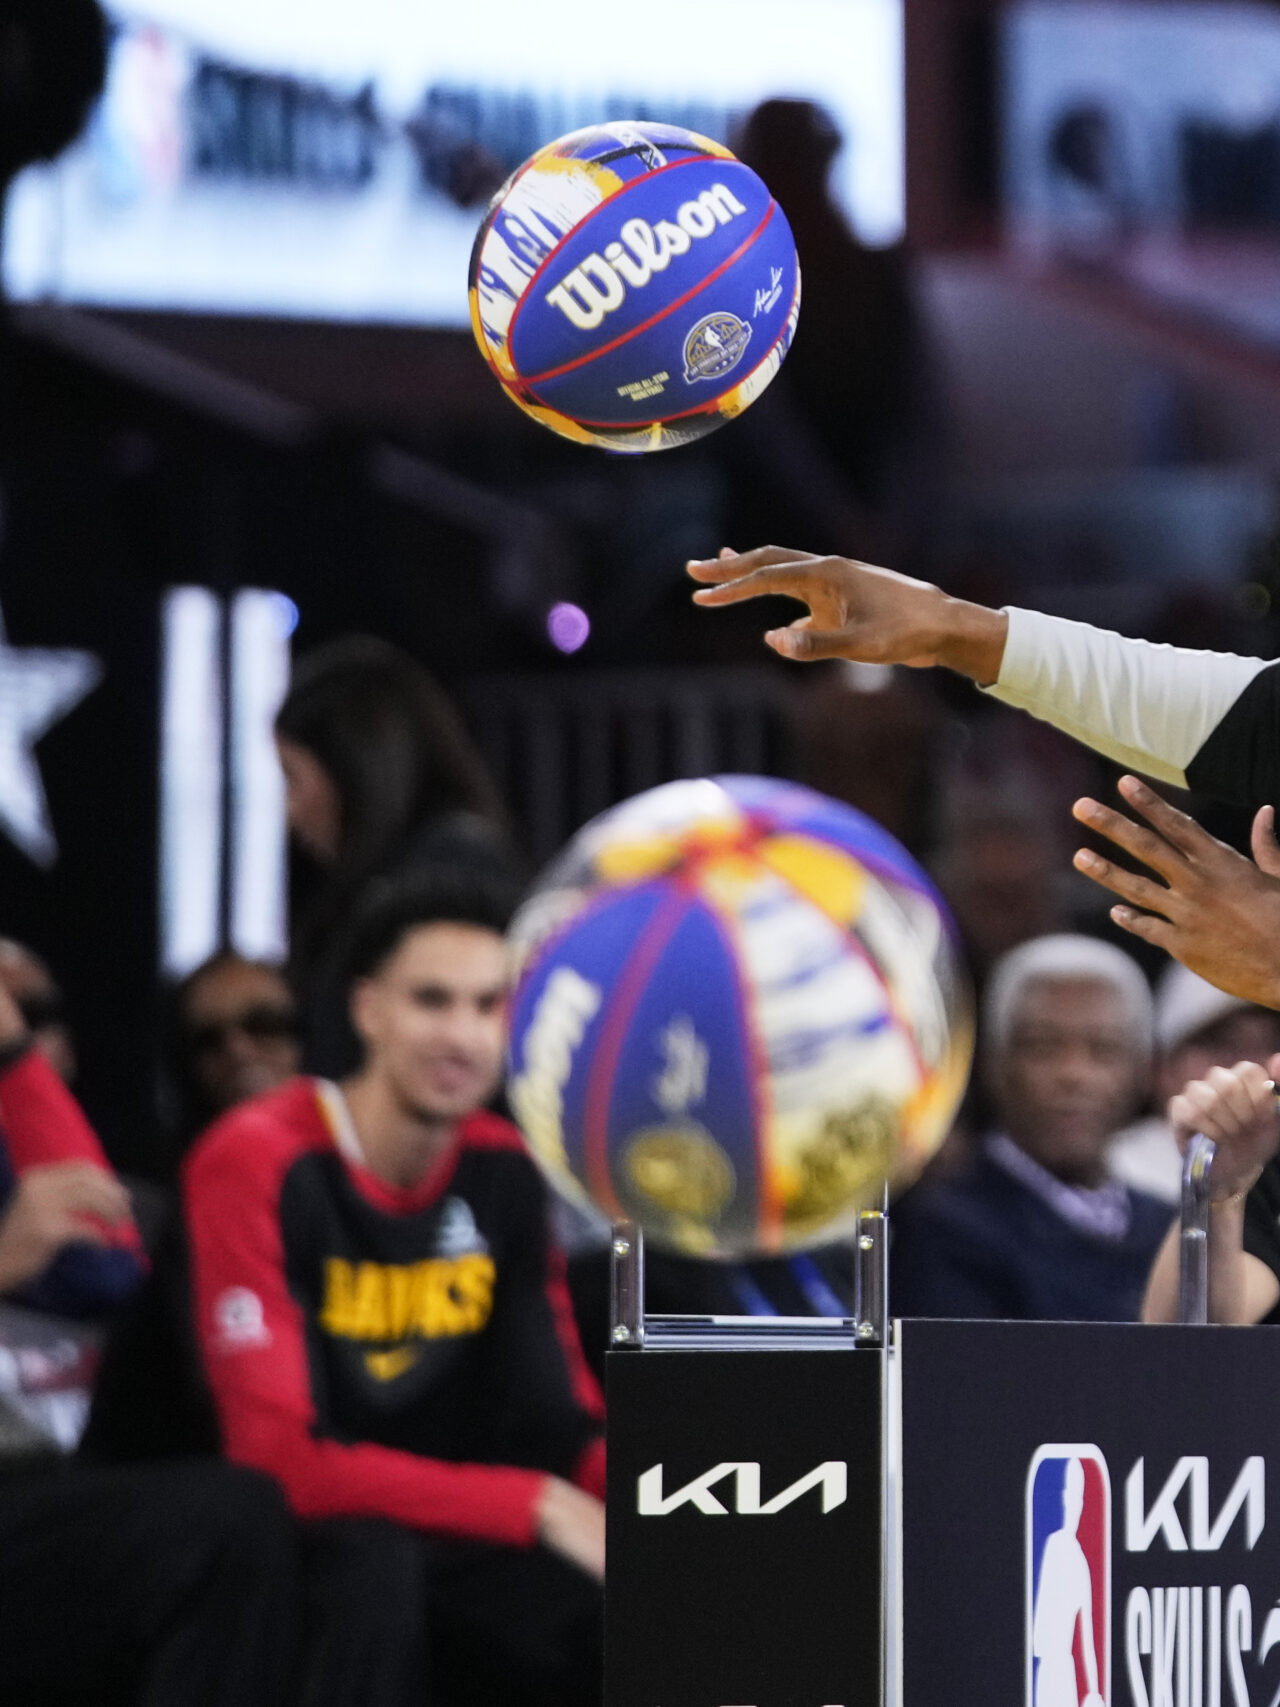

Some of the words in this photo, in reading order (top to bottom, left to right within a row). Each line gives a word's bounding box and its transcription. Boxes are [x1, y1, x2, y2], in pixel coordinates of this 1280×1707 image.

[546, 182, 747, 330] Wilson
[638, 1461, 847, 1515] KIA
[1125, 1456, 1266, 1551] KIA
